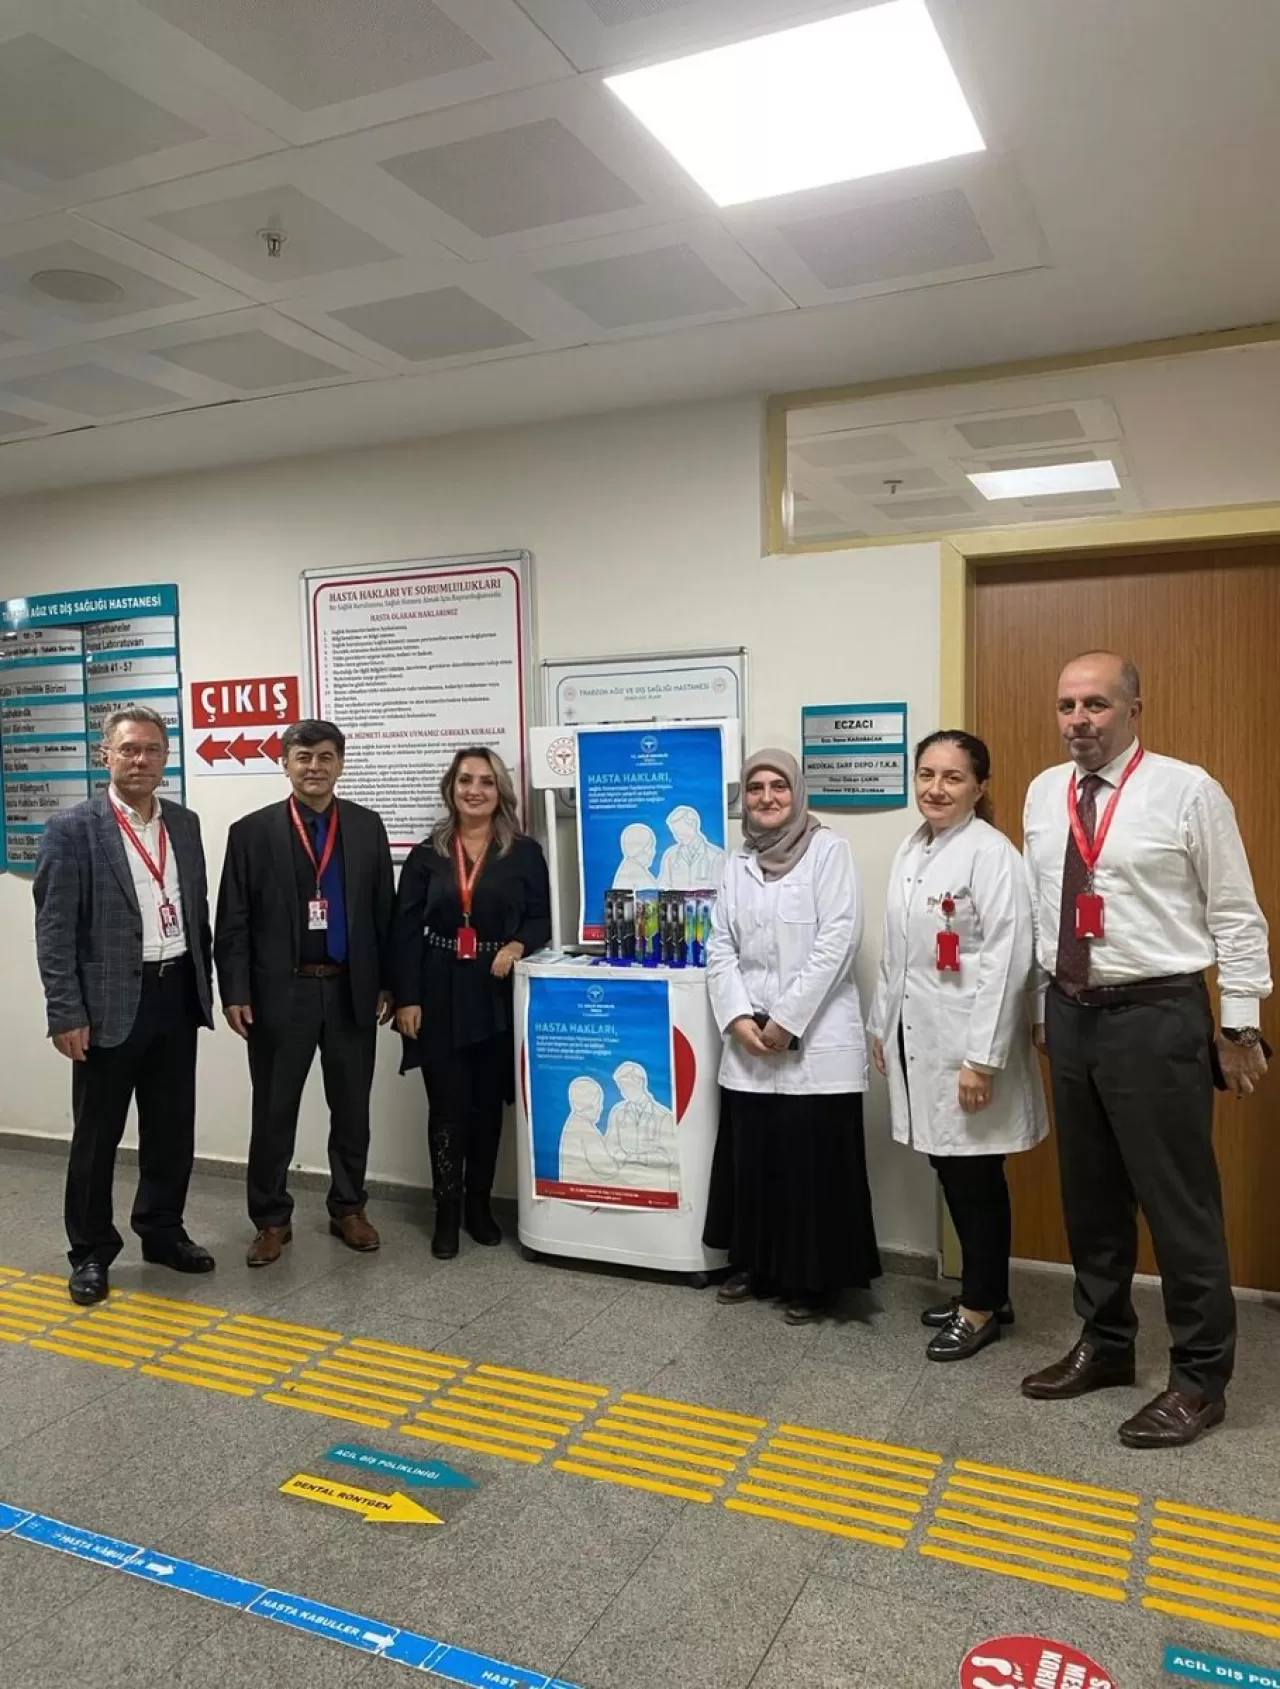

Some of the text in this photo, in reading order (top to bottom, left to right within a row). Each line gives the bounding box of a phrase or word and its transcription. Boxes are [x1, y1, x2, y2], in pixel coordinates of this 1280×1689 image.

[329, 578, 502, 602] HASTA HAKLARI VE SORUMLULUKLARI
[31, 603, 48, 618] AĞIZ
[48, 604, 59, 616] VE
[60, 601, 73, 616] DİŞ
[74, 598, 108, 613] SAĞLIĞI
[109, 592, 162, 609] HASTANESİ
[201, 682, 288, 723] ÇIKIŞ
[834, 719, 874, 730] ECZACI
[588, 773, 621, 784] HASTA
[535, 1022, 569, 1033] HASTA
[293, 1480, 393, 1510] DENTAL RÖNTGEN
[260, 1599, 361, 1636] HASTA KABULLER
[1173, 1657, 1211, 1673] ACİL
[1215, 1667, 1244, 1681] DİŞ
